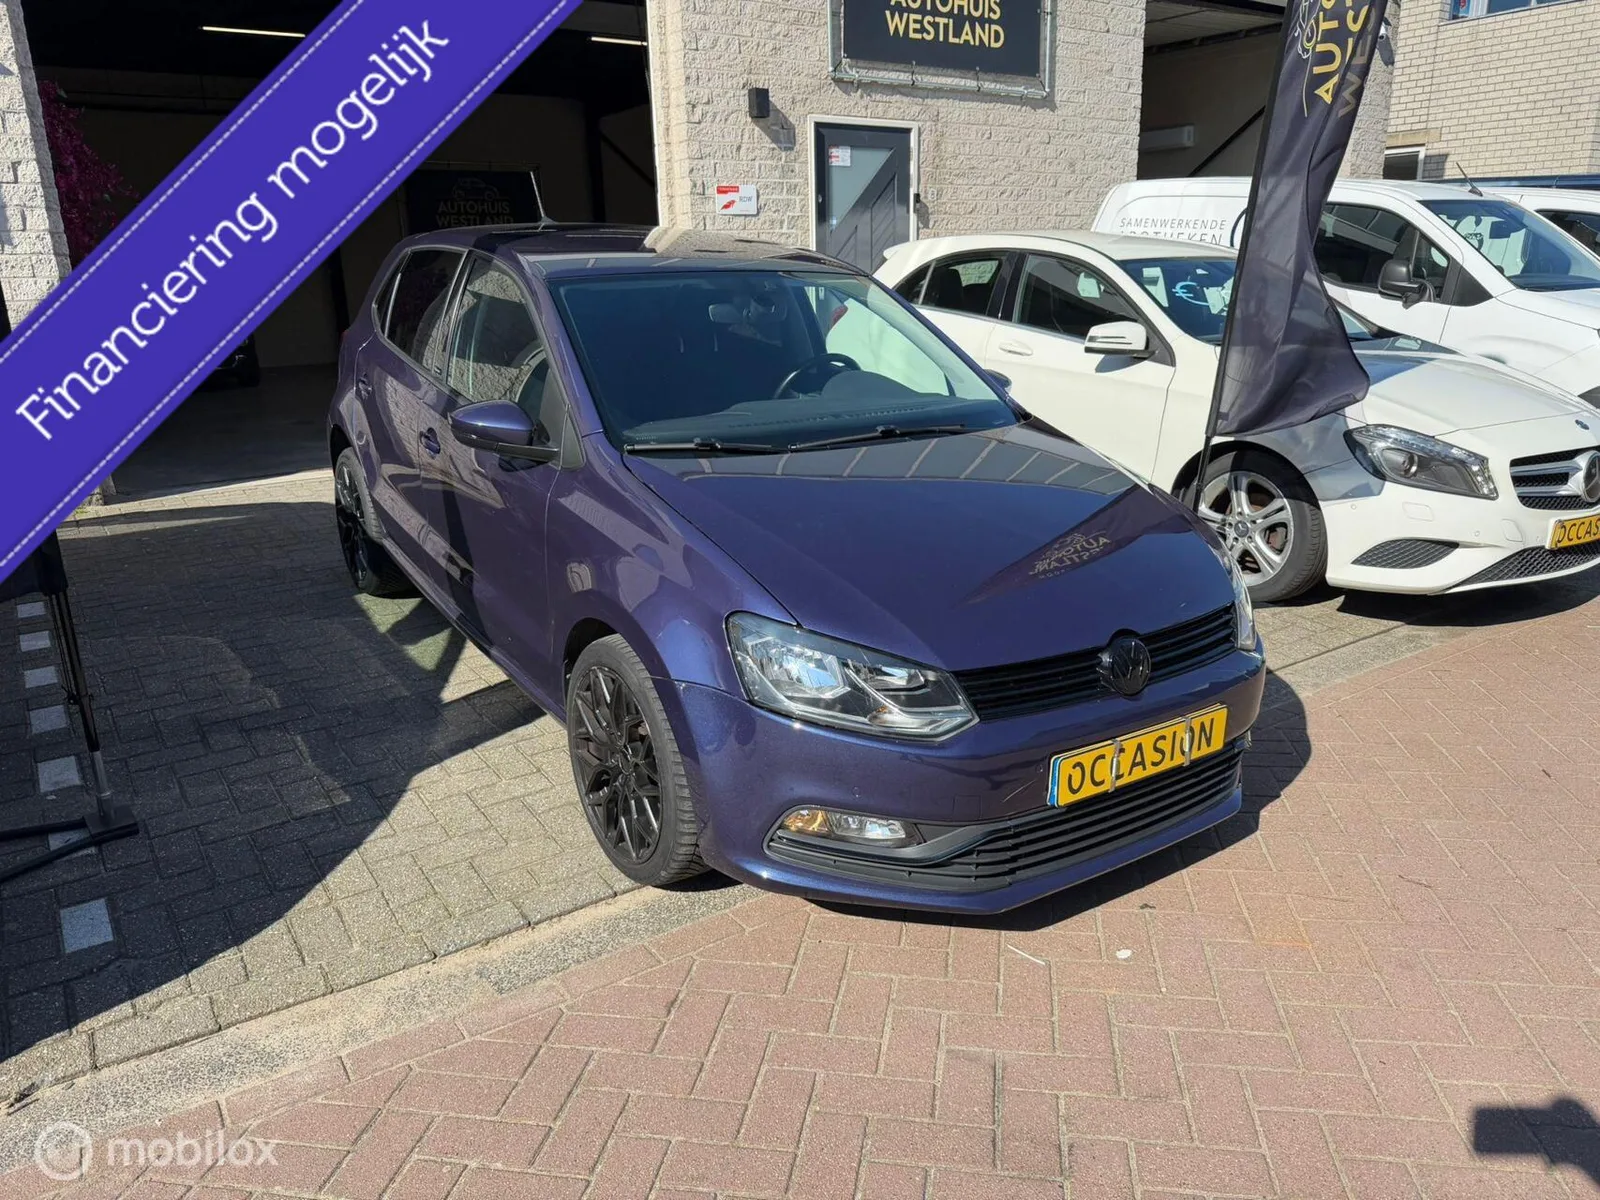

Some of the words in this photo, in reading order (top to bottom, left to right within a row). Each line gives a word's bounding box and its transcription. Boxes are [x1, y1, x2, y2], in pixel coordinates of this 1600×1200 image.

[891, 0, 1000, 20] OHUIS
[885, 10, 1005, 48] WESTLAND
[437, 201, 511, 214] AUTOHUIS
[1119, 217, 1227, 230] SAMENWERKENDE
[1067, 717, 1215, 795] OCCASION
